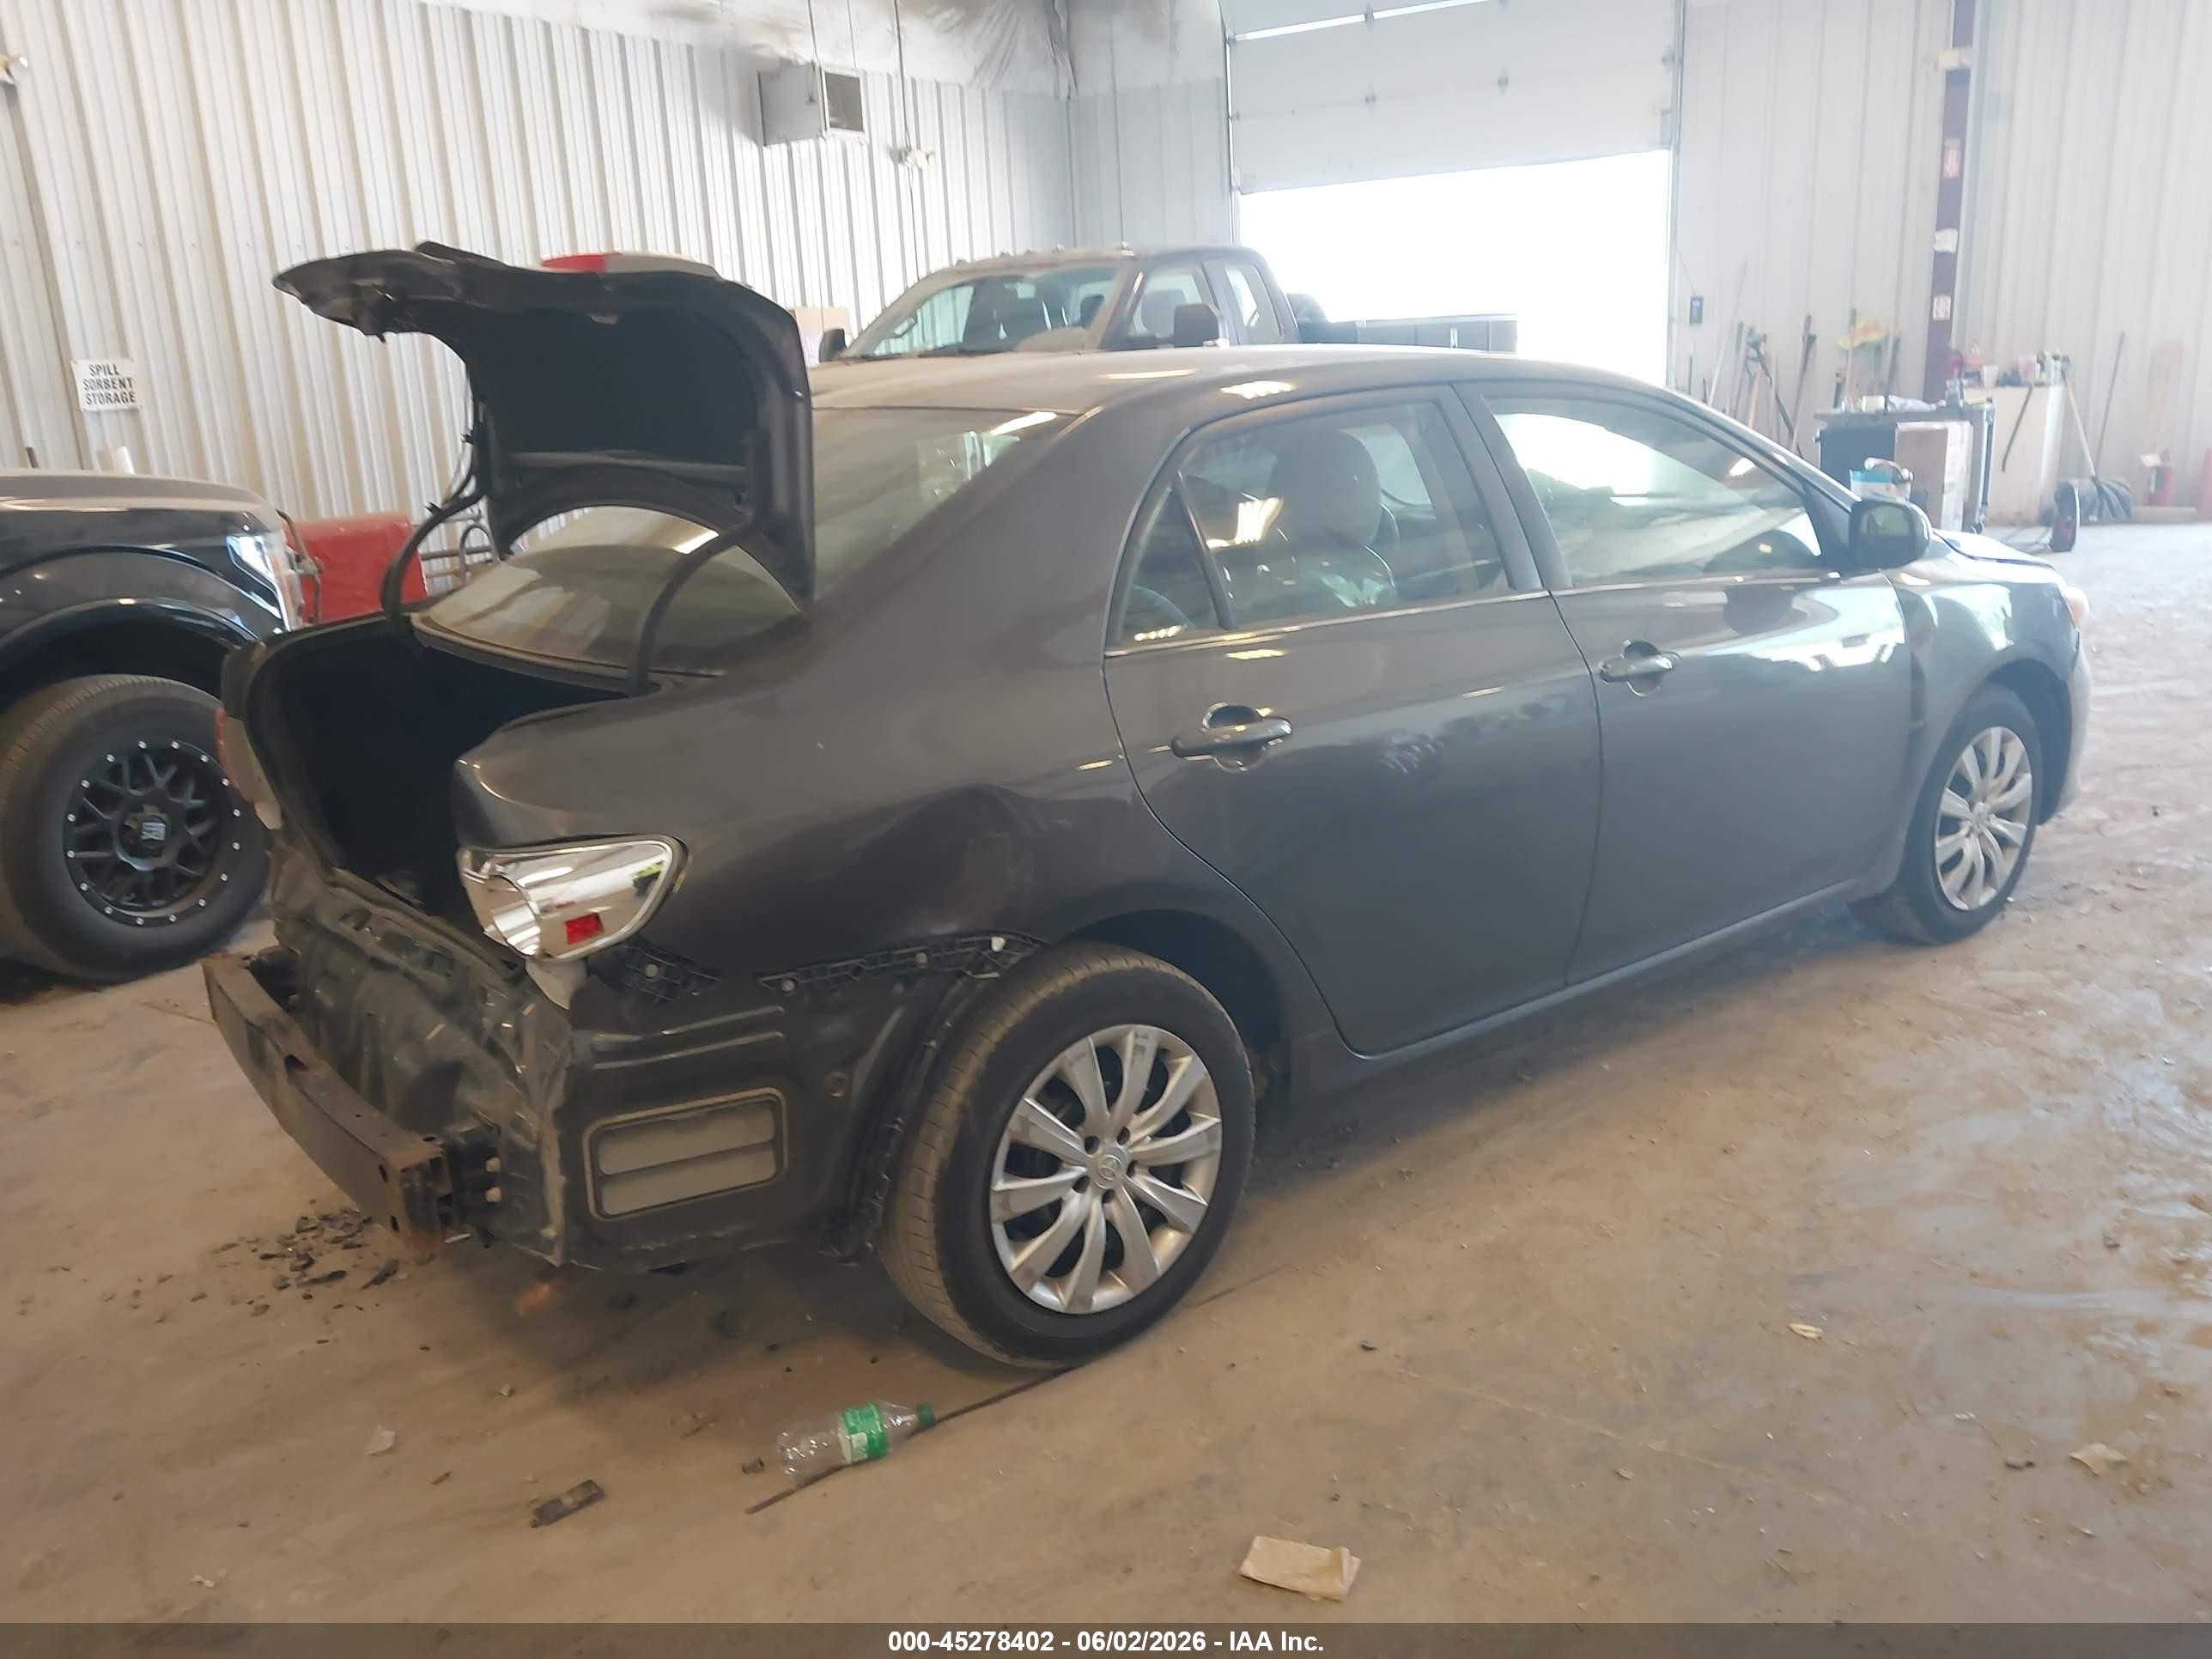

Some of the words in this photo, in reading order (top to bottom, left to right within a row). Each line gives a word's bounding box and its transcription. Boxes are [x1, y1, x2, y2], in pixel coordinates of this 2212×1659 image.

[88, 364, 119, 376] SPILL
[83, 378, 133, 391] SORBENT
[86, 392, 136, 405] STORAGE
